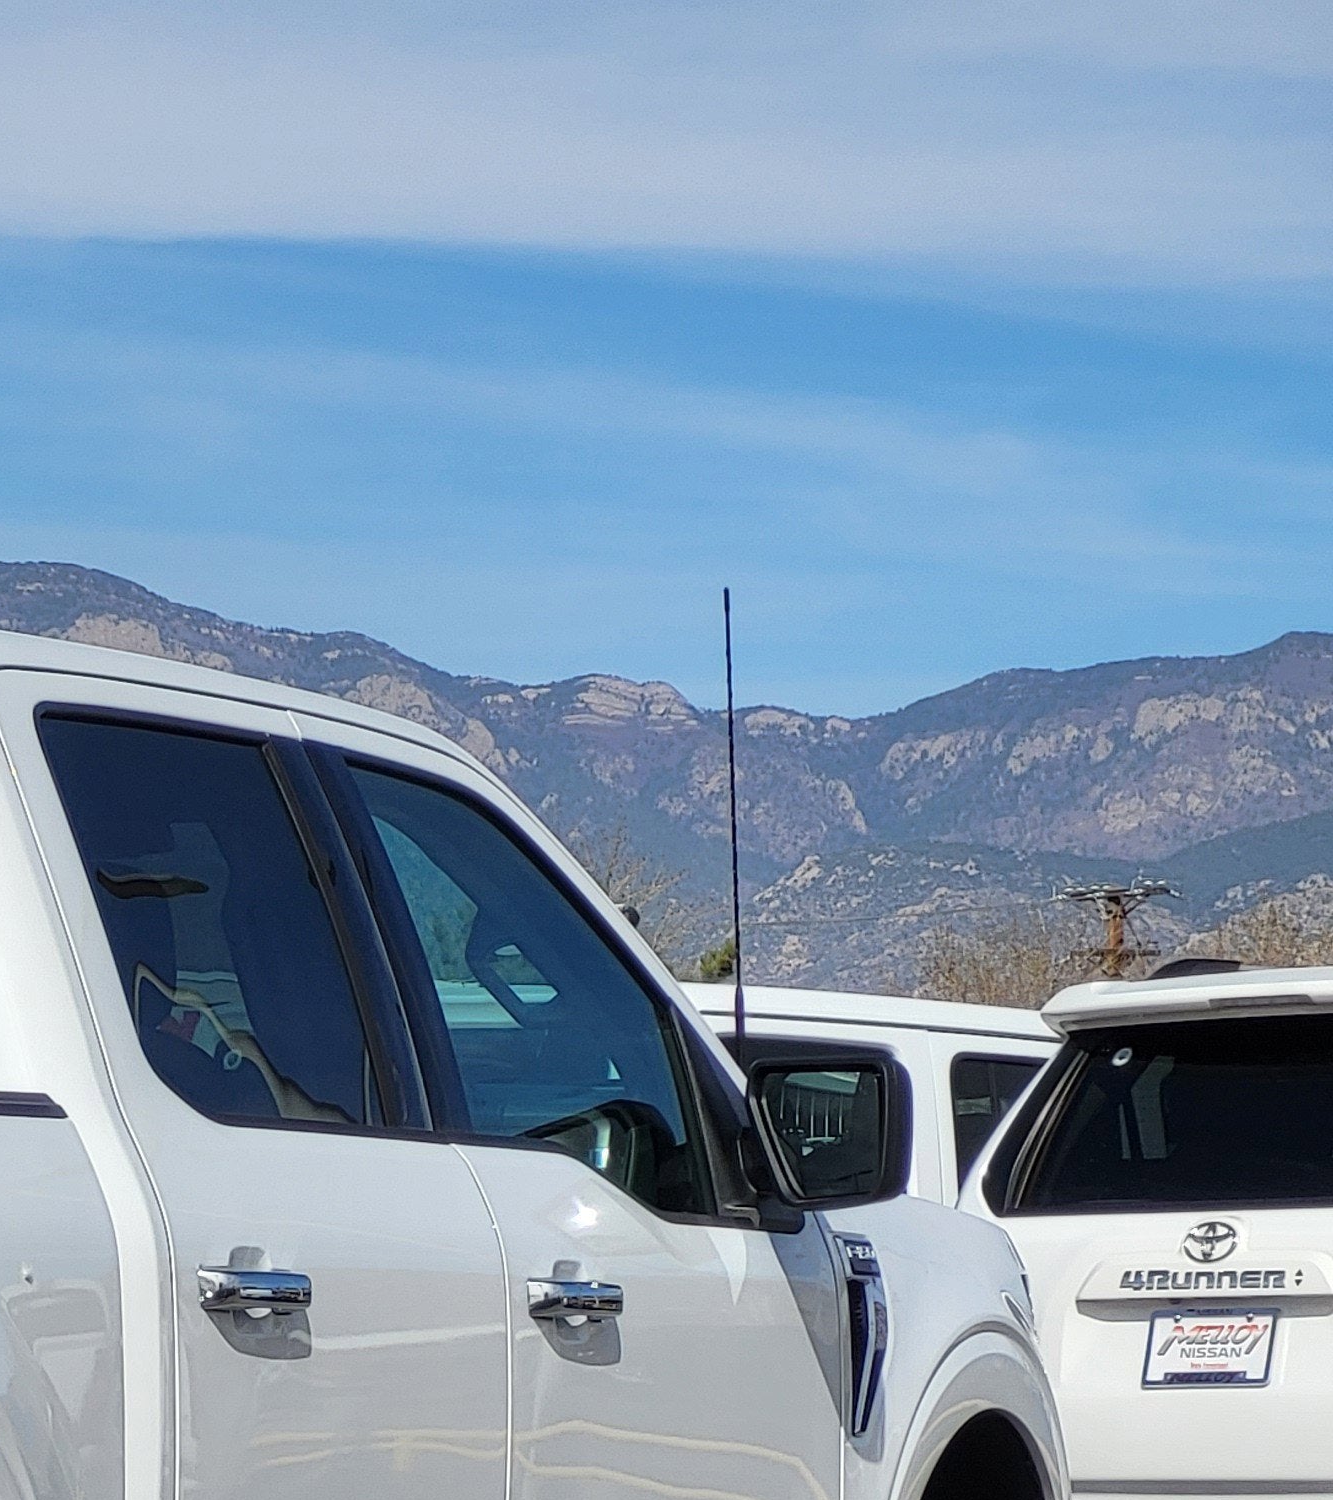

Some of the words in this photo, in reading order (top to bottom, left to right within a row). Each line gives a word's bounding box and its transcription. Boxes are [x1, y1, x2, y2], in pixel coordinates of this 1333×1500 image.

[1119, 1269, 1286, 1291] 4RUNNER
[1157, 1324, 1269, 1356] MELLOY
[1180, 1347, 1242, 1358] NISSAN
